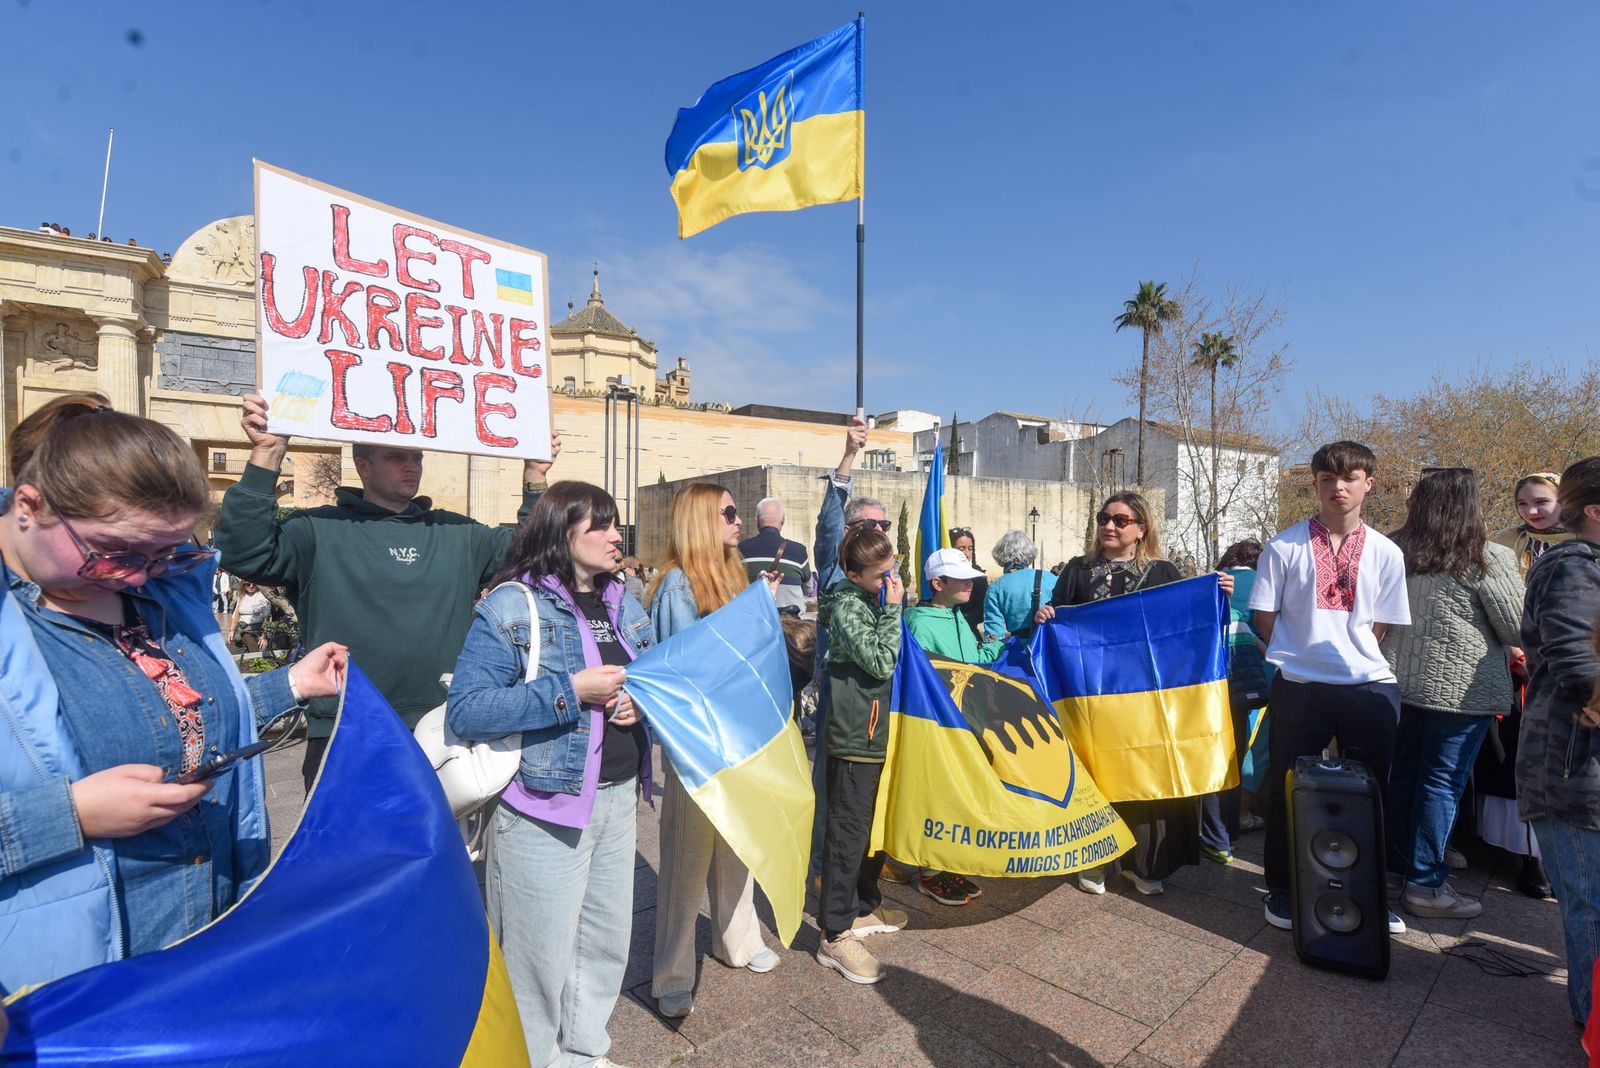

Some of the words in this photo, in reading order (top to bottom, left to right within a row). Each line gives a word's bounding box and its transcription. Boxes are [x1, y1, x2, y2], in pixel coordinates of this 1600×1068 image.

[331, 204, 491, 299] LET
[261, 251, 542, 378] UKREINE
[325, 349, 518, 447] LIFE
[924, 818, 971, 845] 92-ГА
[976, 829, 1040, 850] ОКРЕМА
[1005, 854, 1061, 873] AMIGOS
[1064, 849, 1078, 869] DE
[1081, 834, 1120, 864] CORDOBA
